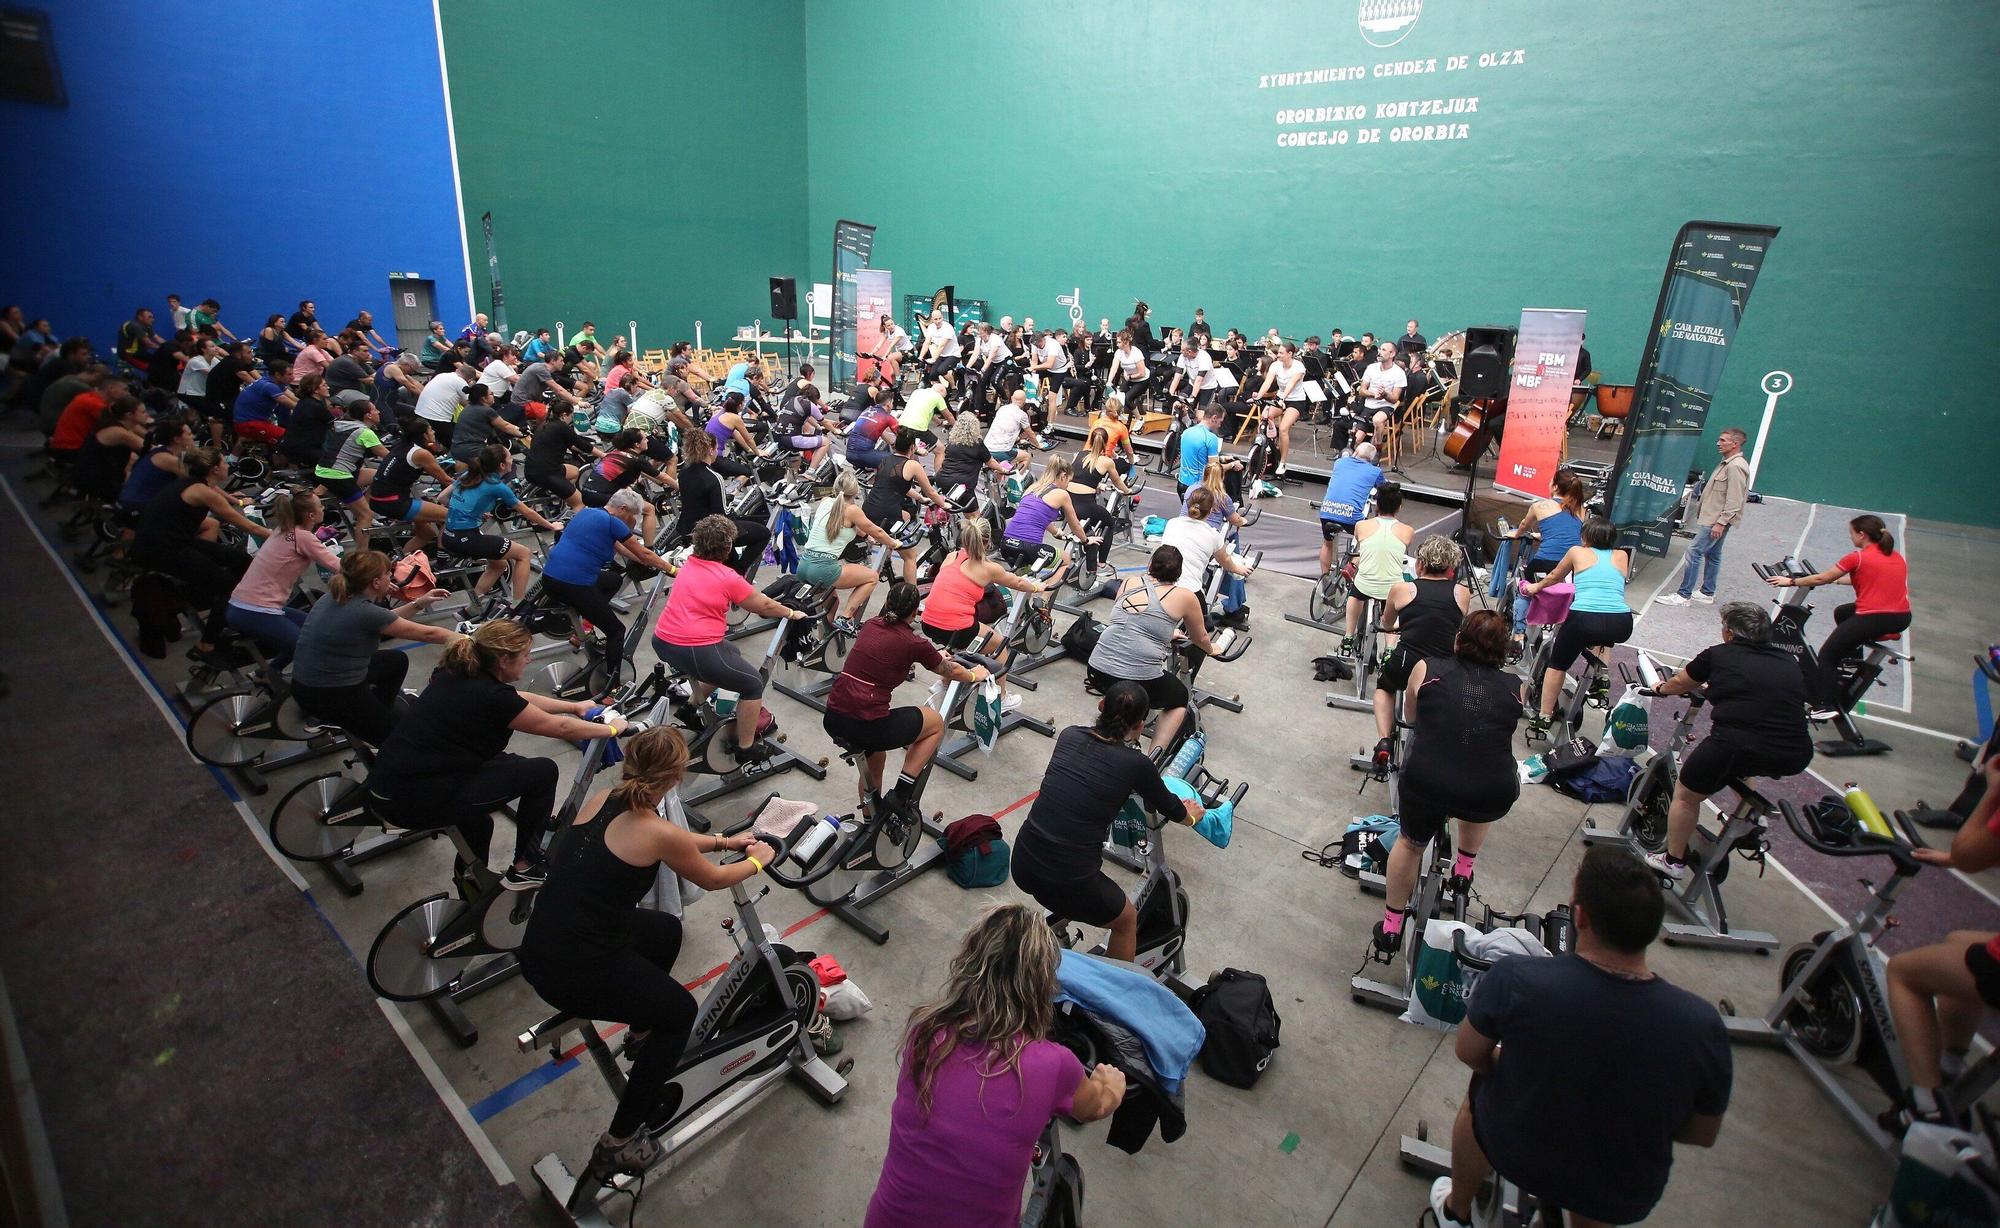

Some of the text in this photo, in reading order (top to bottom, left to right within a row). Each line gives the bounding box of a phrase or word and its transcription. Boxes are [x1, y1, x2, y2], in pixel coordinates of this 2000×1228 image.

[1258, 49, 1526, 89] AYUNTAMIENTO CENDEA DE OLZA
[1276, 97, 1480, 125] ORORBIAKO KONTZEJUA
[1277, 128, 1349, 147] CONCEJO
[1356, 127, 1381, 144] DE
[1671, 330, 1726, 346] DE NAVARRA
[1692, 325, 1724, 337] RURAL
[1538, 352, 1566, 367] FBM
[1516, 373, 1542, 388] MBF
[1771, 378, 1782, 388] 3
[1513, 463, 1523, 476] N
[695, 960, 751, 1040] SPINNING
[1860, 959, 1897, 1042] SPINNING
